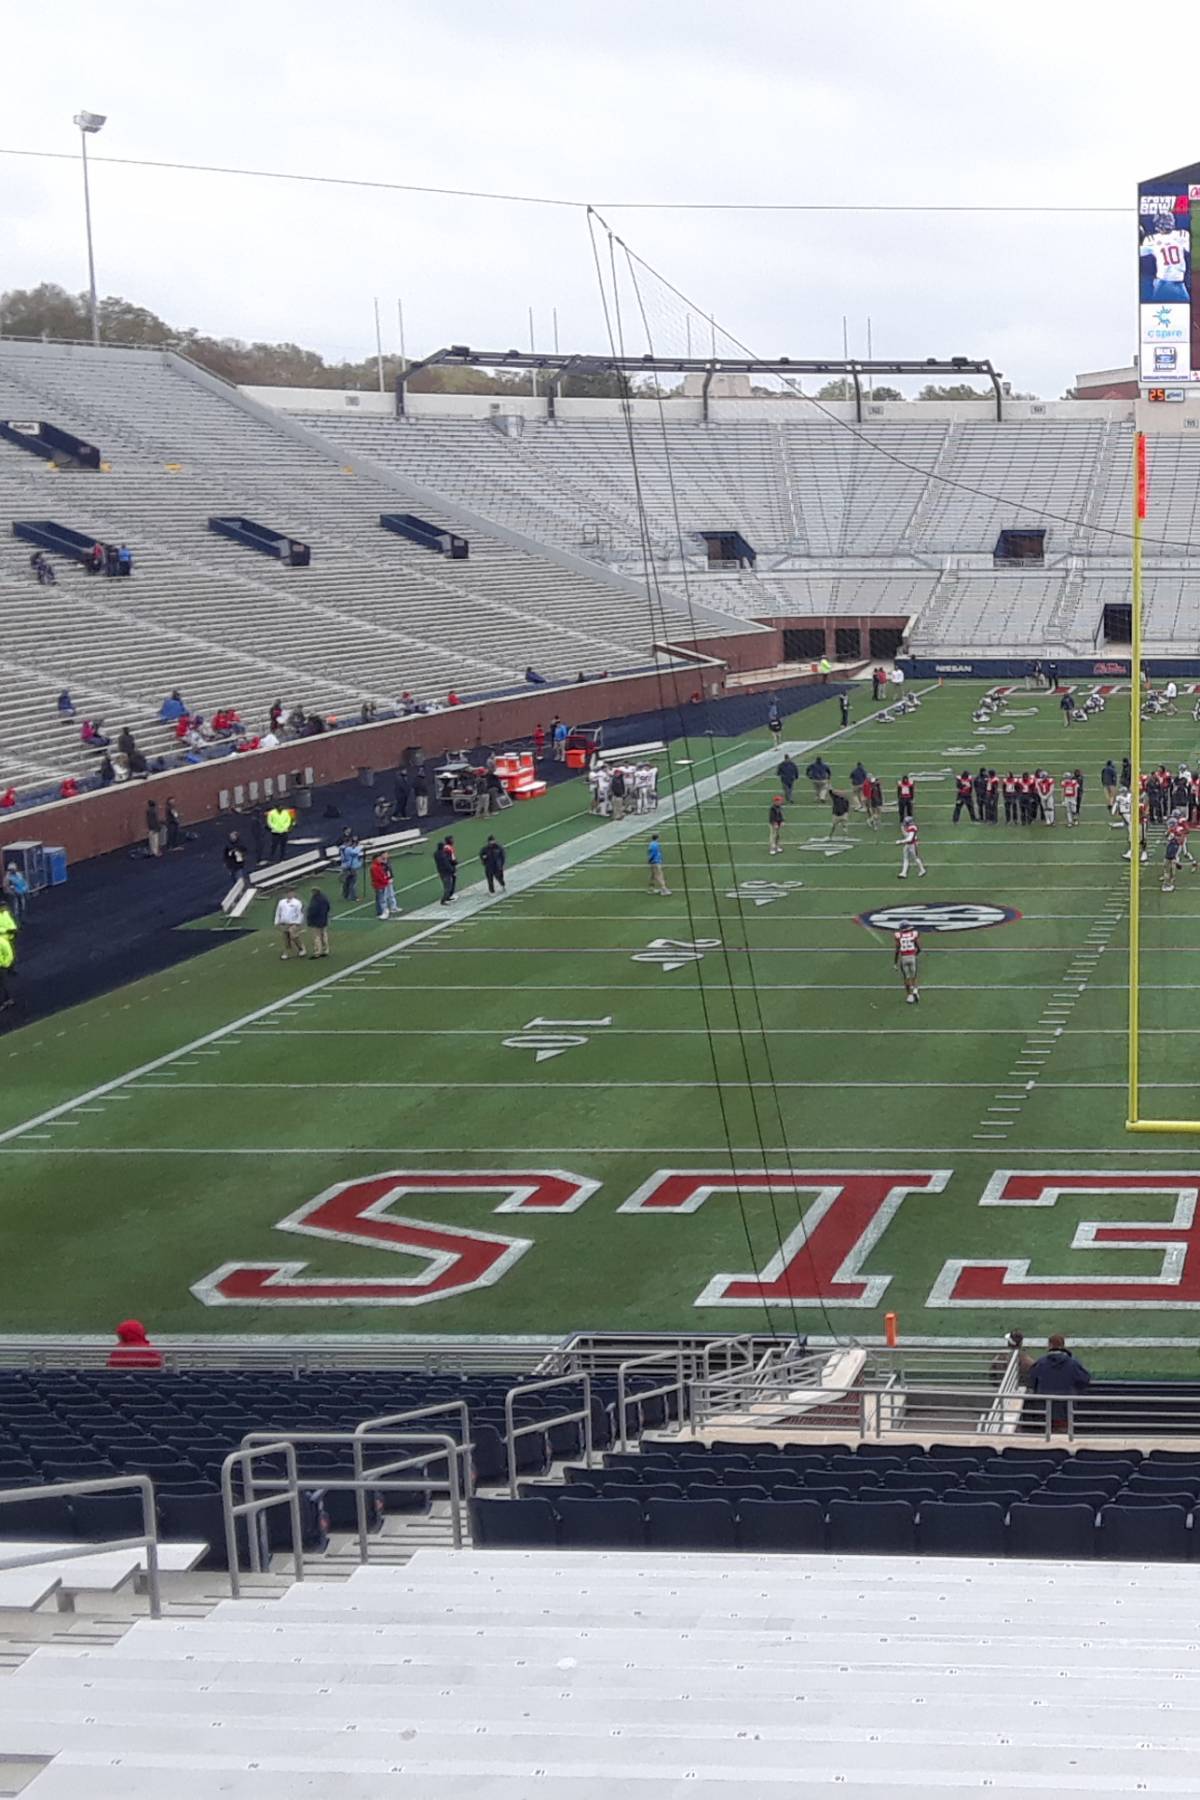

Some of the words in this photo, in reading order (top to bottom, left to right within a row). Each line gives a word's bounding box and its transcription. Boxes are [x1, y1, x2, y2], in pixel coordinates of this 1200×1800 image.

[1160, 246, 1181, 266] 10
[1149, 389, 1165, 401] 25
[936, 664, 972, 673] NISSAN
[630, 937, 722, 962] 20
[500, 1015, 613, 1053] 10
